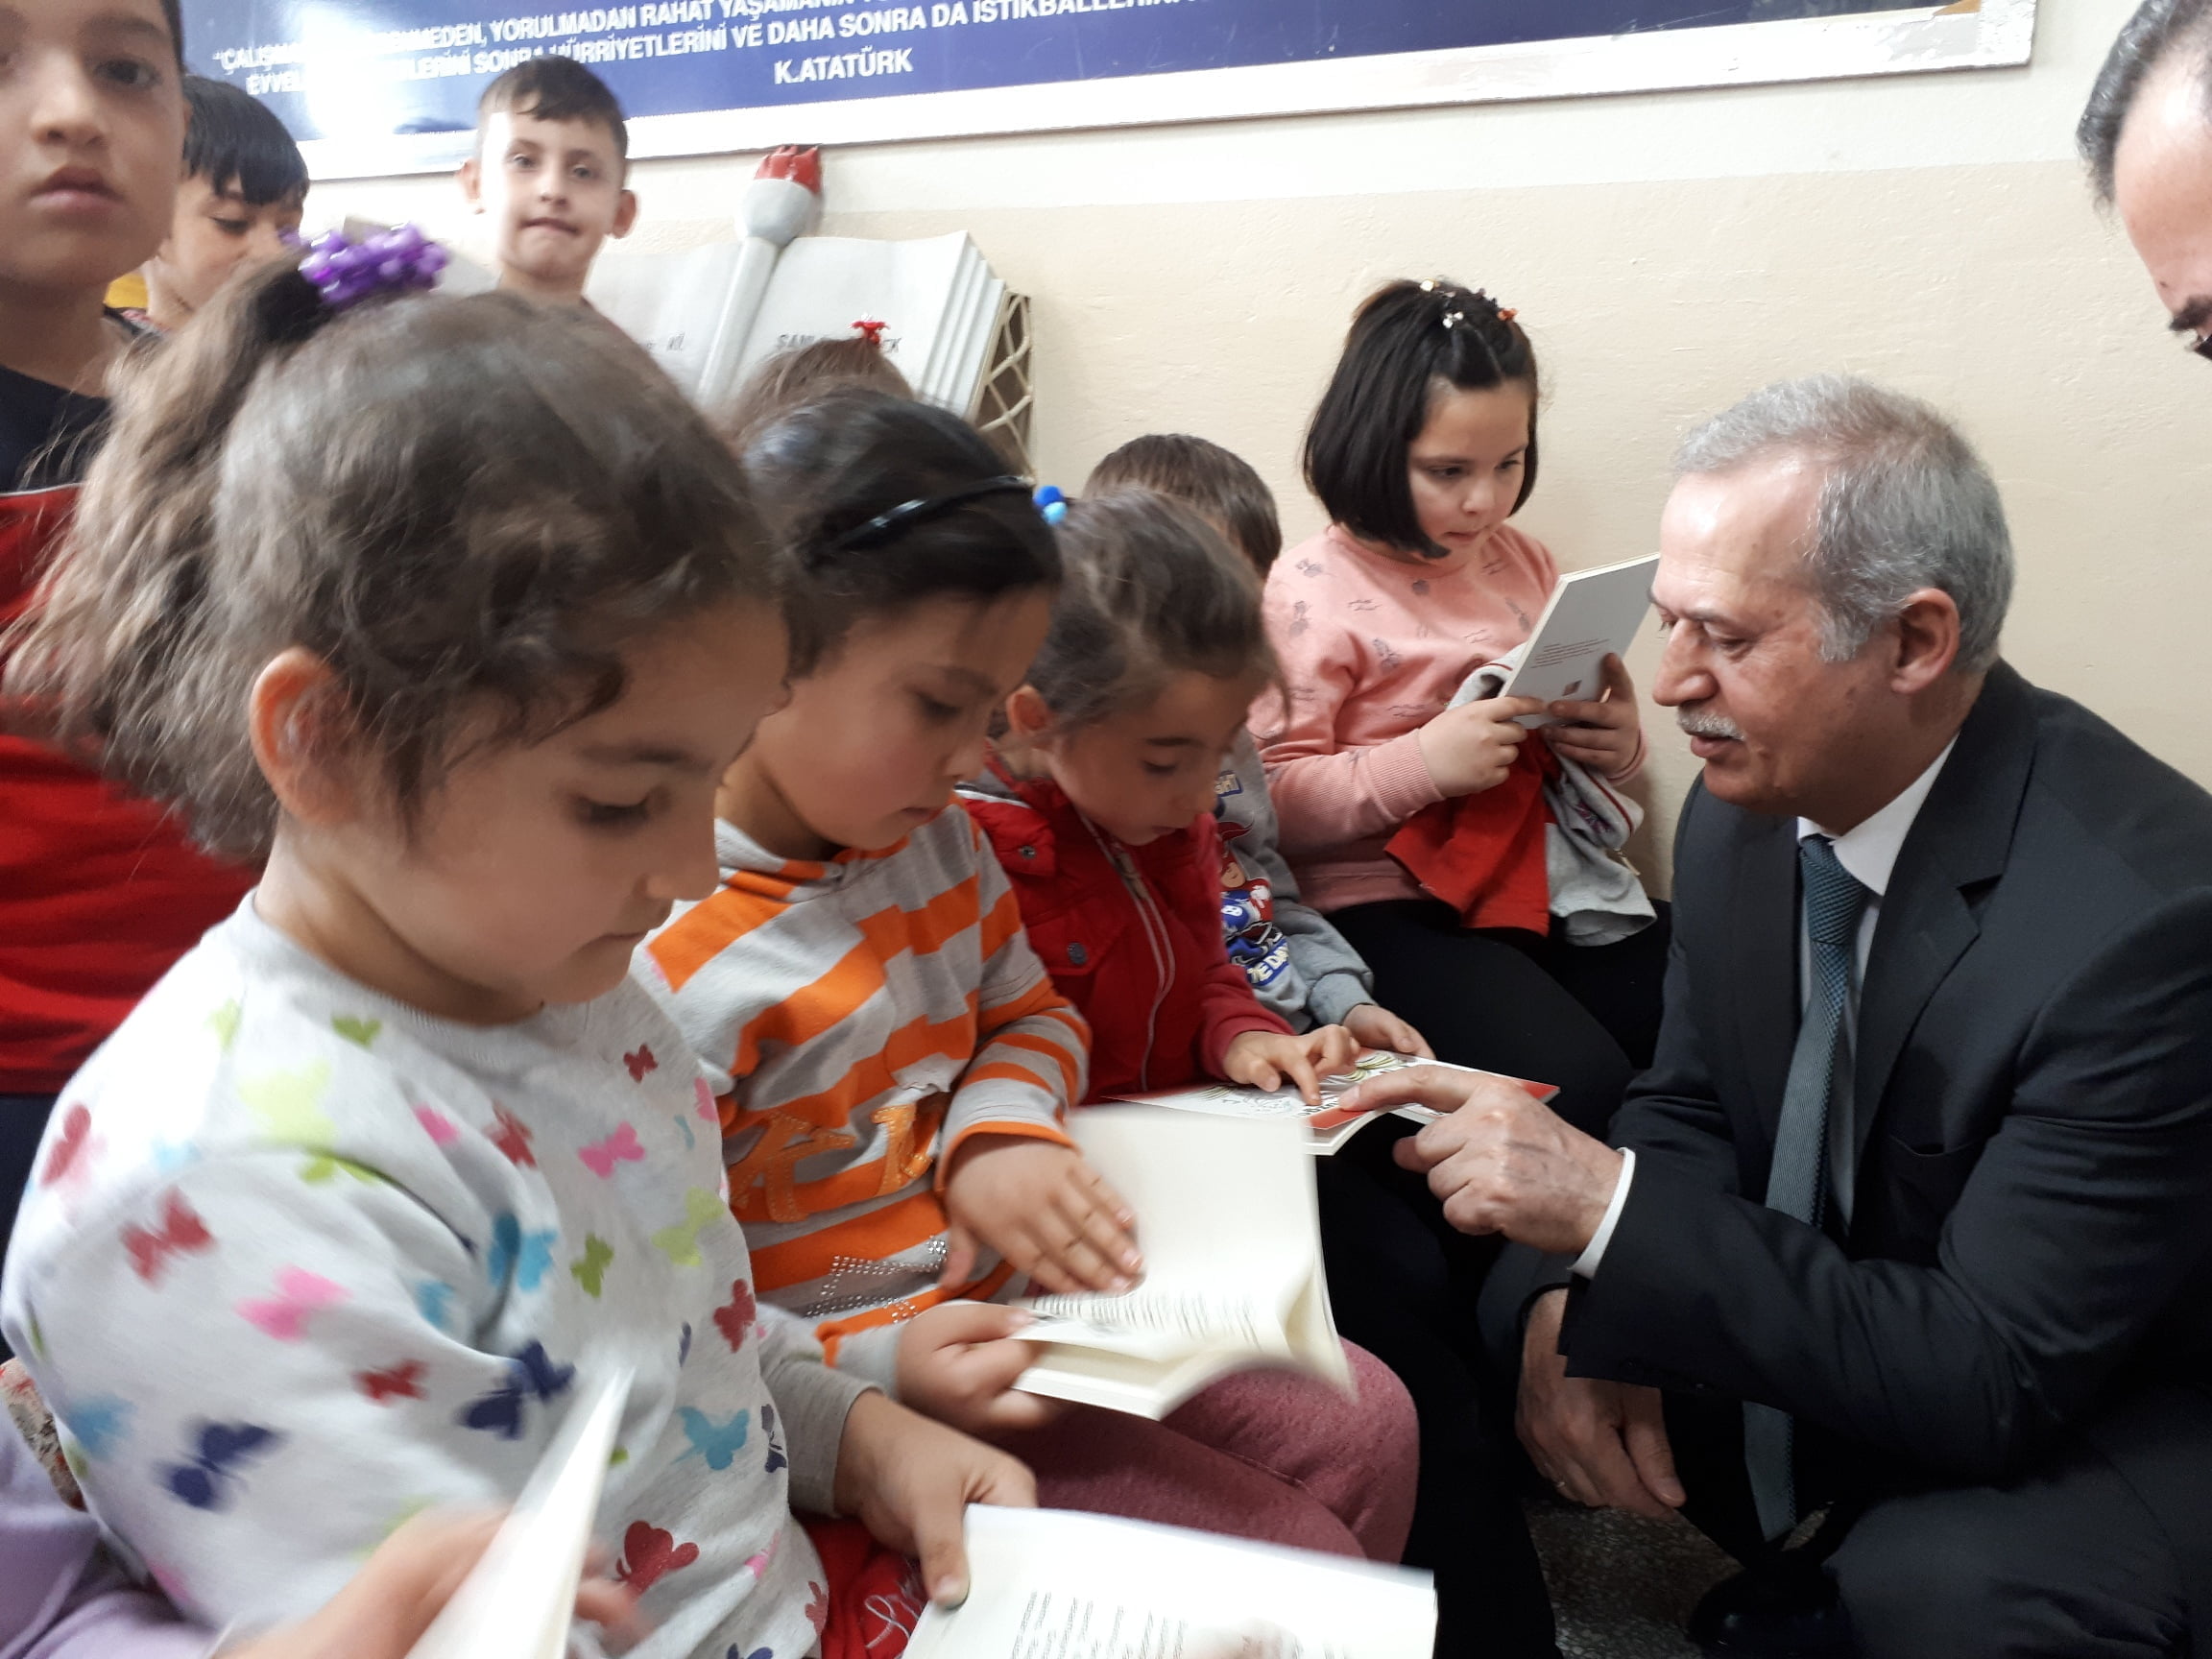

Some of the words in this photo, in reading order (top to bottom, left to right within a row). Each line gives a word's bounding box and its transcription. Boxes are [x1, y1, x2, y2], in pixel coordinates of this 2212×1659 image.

[489, 5, 636, 41] YORULMADAN
[639, 0, 713, 26] RAHAT
[731, 23, 763, 49] VE
[767, 14, 835, 45] DAHA
[838, 6, 926, 37] SONRA
[931, 3, 969, 28] DA
[774, 45, 913, 84] K.ATATÜRK
